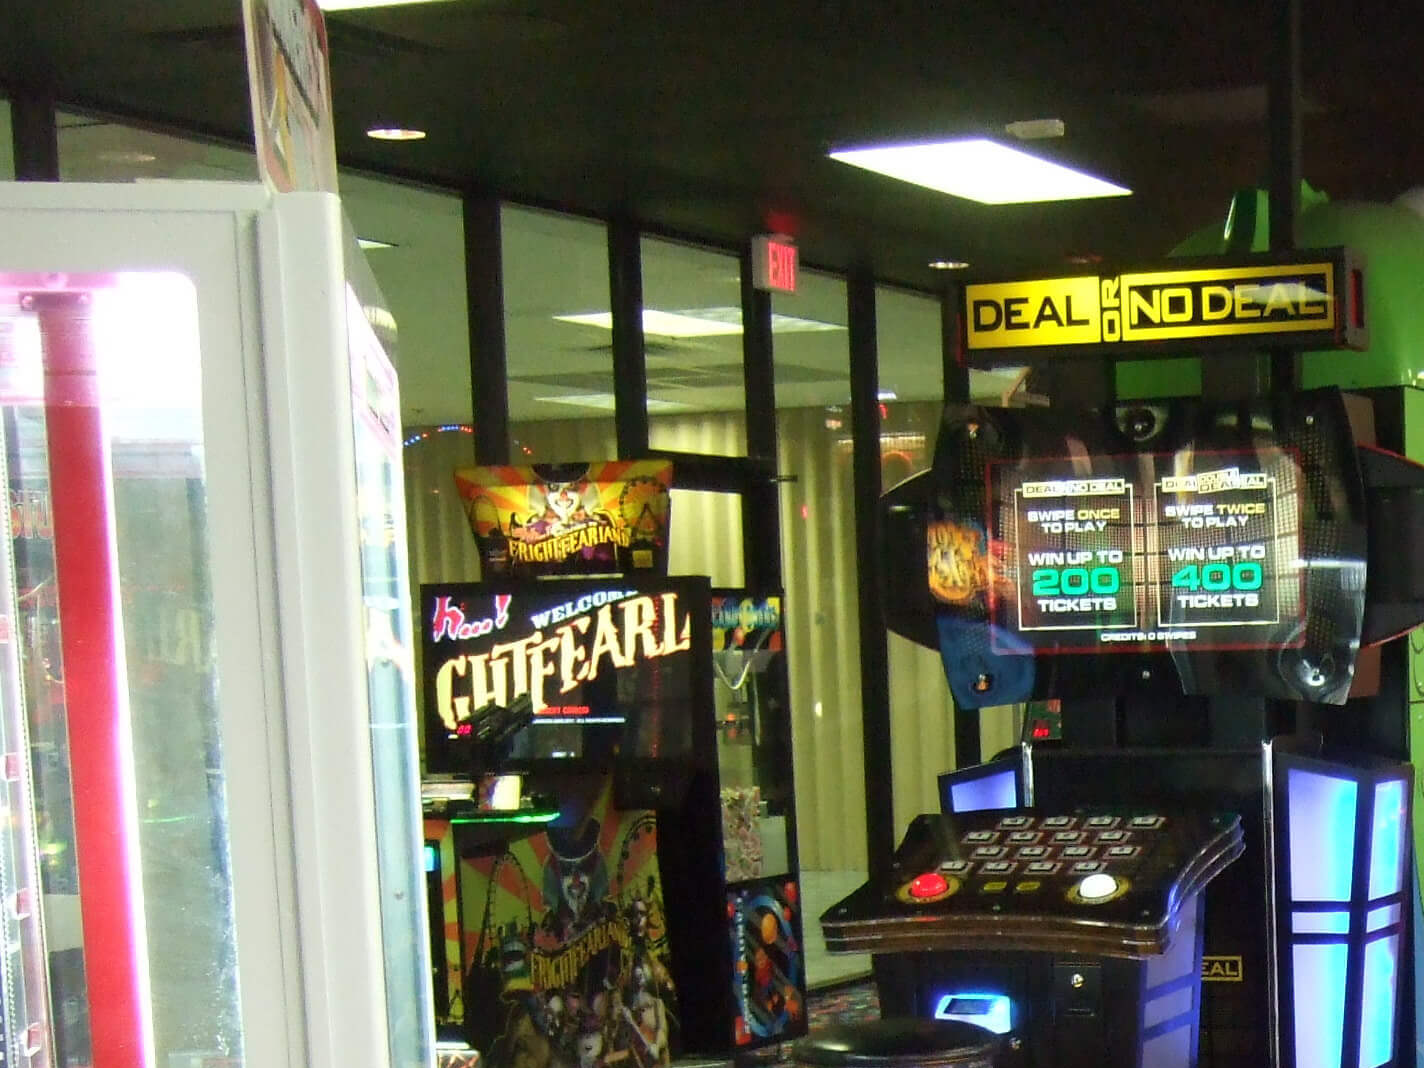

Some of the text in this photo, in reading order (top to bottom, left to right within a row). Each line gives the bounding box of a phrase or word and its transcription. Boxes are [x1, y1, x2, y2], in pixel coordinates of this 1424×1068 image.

[973, 277, 1326, 342] DEAL OR NO DEAL
[1027, 508, 1120, 522] SWIPE ONCE
[1165, 503, 1266, 517] SWIPE TWICE
[1041, 520, 1107, 533] TO PLAY
[1181, 515, 1249, 529] TO PLAY
[1028, 550, 1123, 566] WIN UP TO
[1168, 545, 1266, 562] WIN UP TO
[1032, 567, 1120, 596] 200
[1171, 562, 1262, 592] 400
[1037, 598, 1117, 613] TICKETS
[1177, 594, 1259, 609] TICKETS
[530, 590, 639, 630] WELCOM
